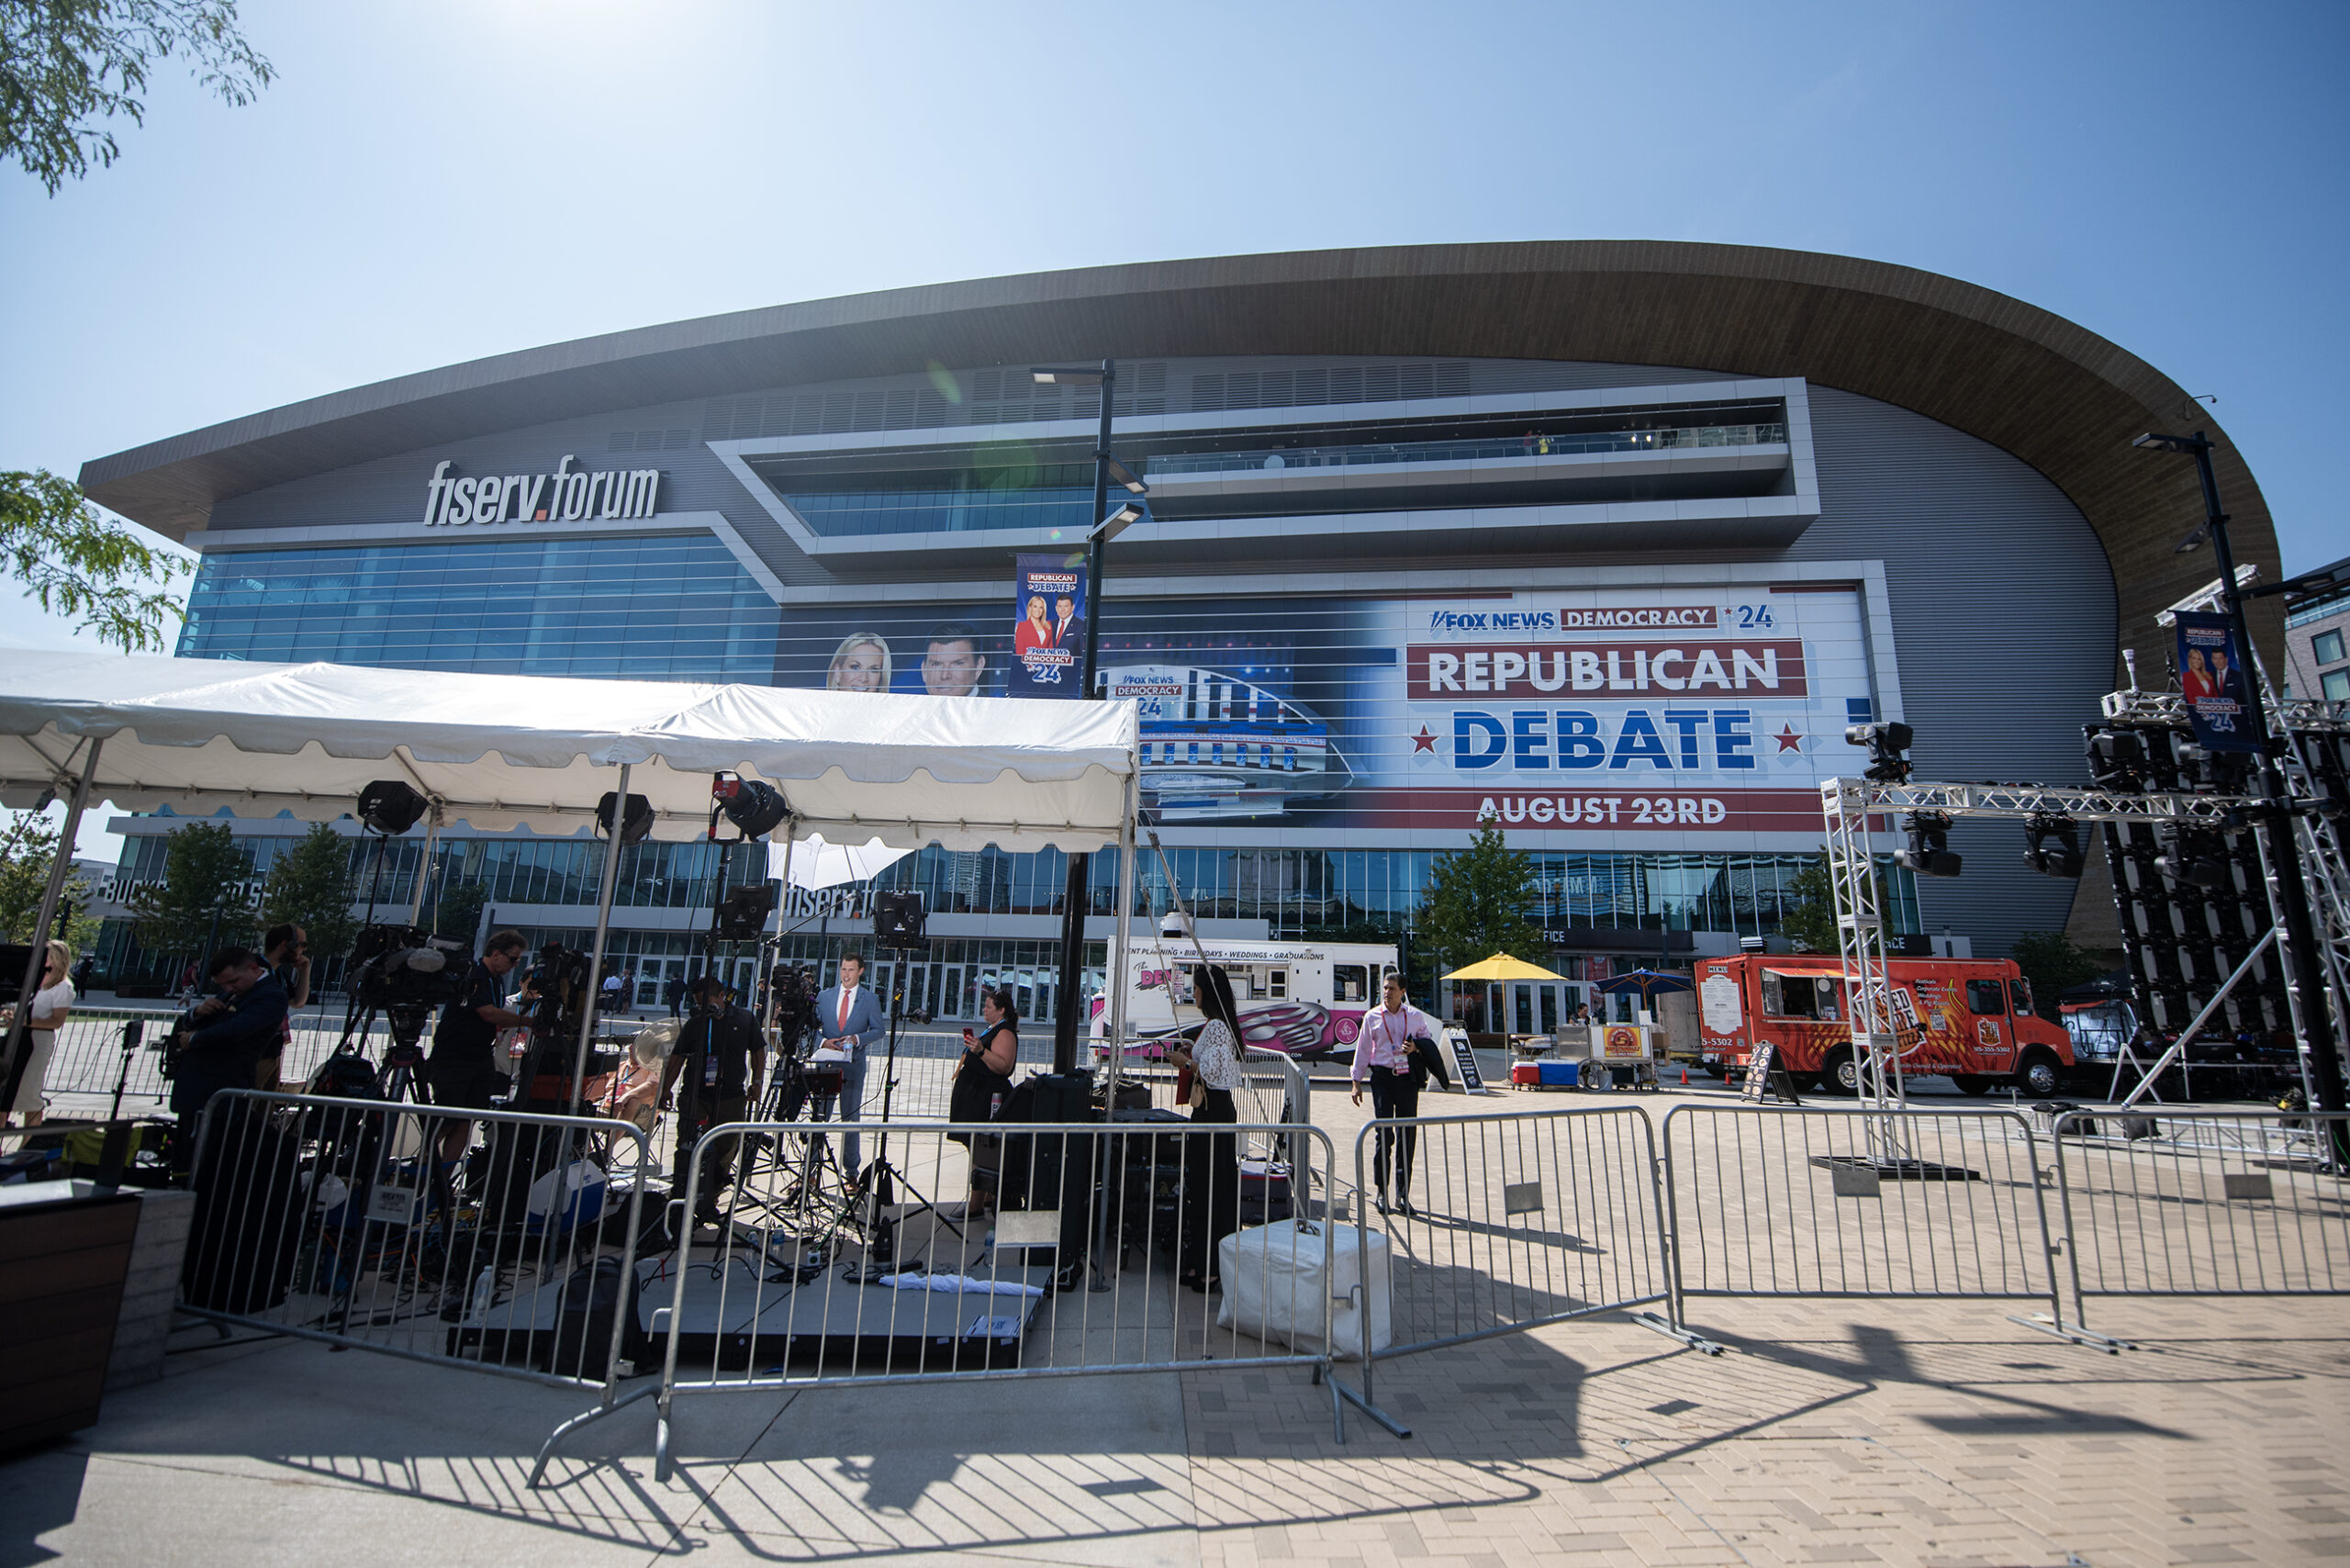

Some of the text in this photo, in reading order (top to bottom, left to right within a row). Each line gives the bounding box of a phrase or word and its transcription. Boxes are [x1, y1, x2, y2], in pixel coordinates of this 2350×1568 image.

[1030, 574, 1073, 582] REPUBLICAN
[1033, 582, 1069, 592] DEBATE
[1445, 605, 1774, 631] FOX NEWS DEMOCRACY 24
[1033, 664, 1059, 681] 24
[1428, 648, 1779, 691] REPUBLICAN
[1147, 676, 1174, 684] NEWS
[1117, 686, 1180, 696] DEMOCRACY
[1138, 697, 1161, 715] 24
[2196, 703, 2236, 712] DEMOCRACY
[2208, 712, 2232, 730] 24
[1451, 708, 1756, 771] DEBATE
[1475, 797, 1726, 824] AUGUST 23RD
